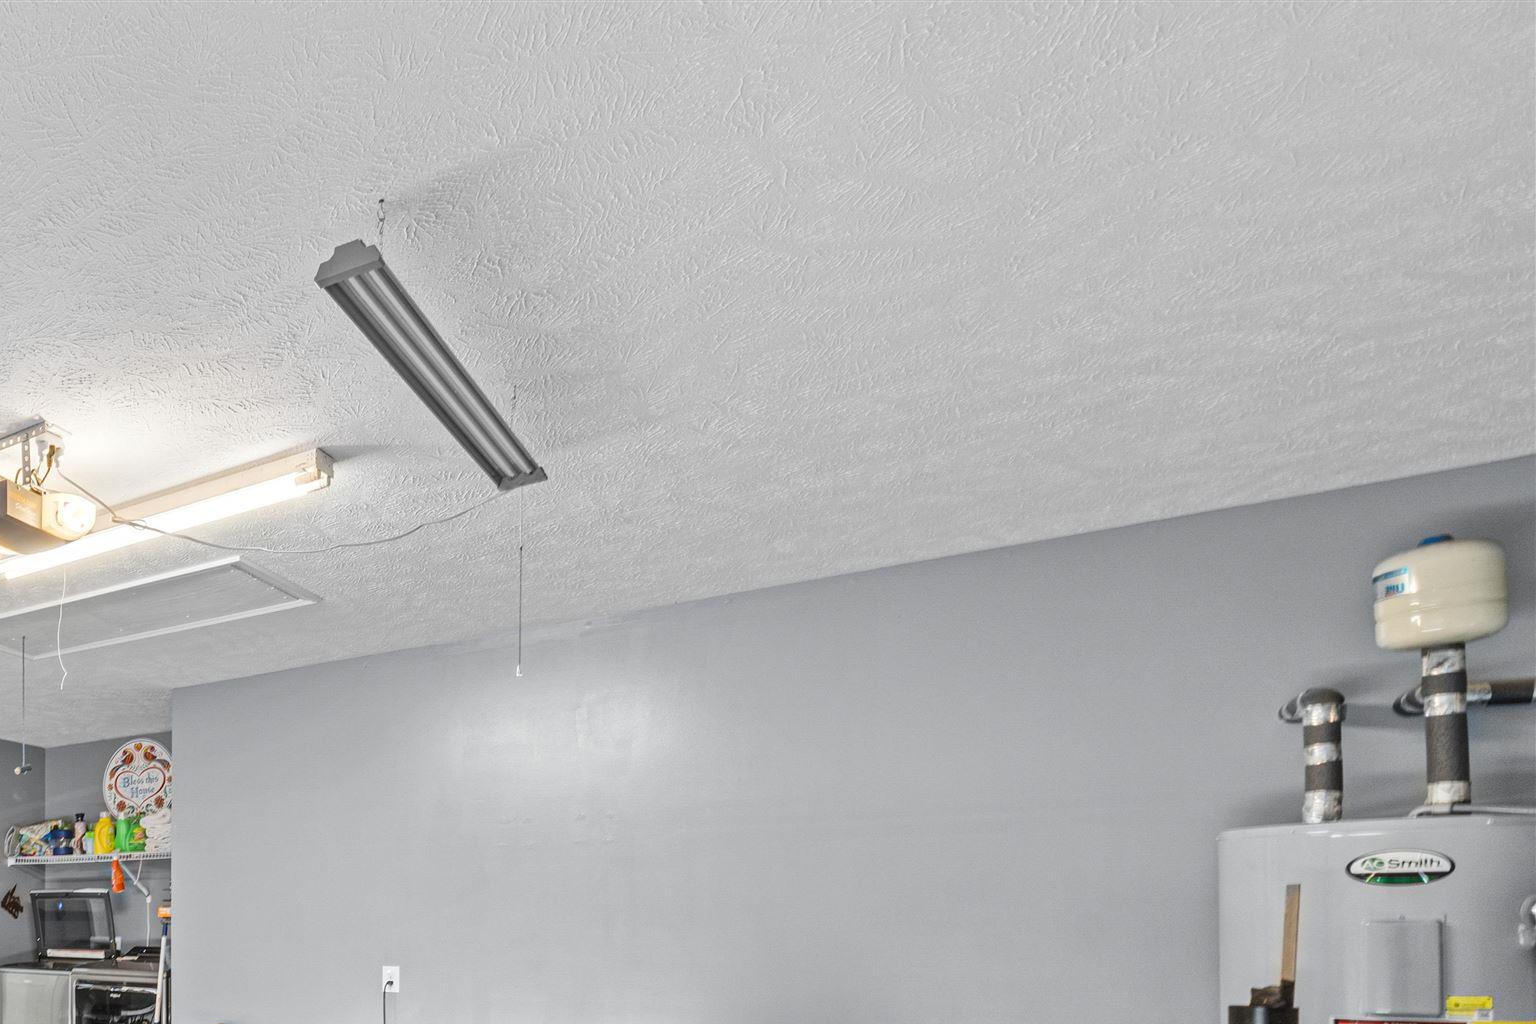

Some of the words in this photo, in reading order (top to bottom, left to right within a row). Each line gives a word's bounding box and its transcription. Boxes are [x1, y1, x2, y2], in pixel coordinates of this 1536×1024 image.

[122, 774, 144, 788] Bless
[146, 772, 159, 784] this
[130, 786, 155, 798] House
[1387, 858, 1441, 869] Smith
